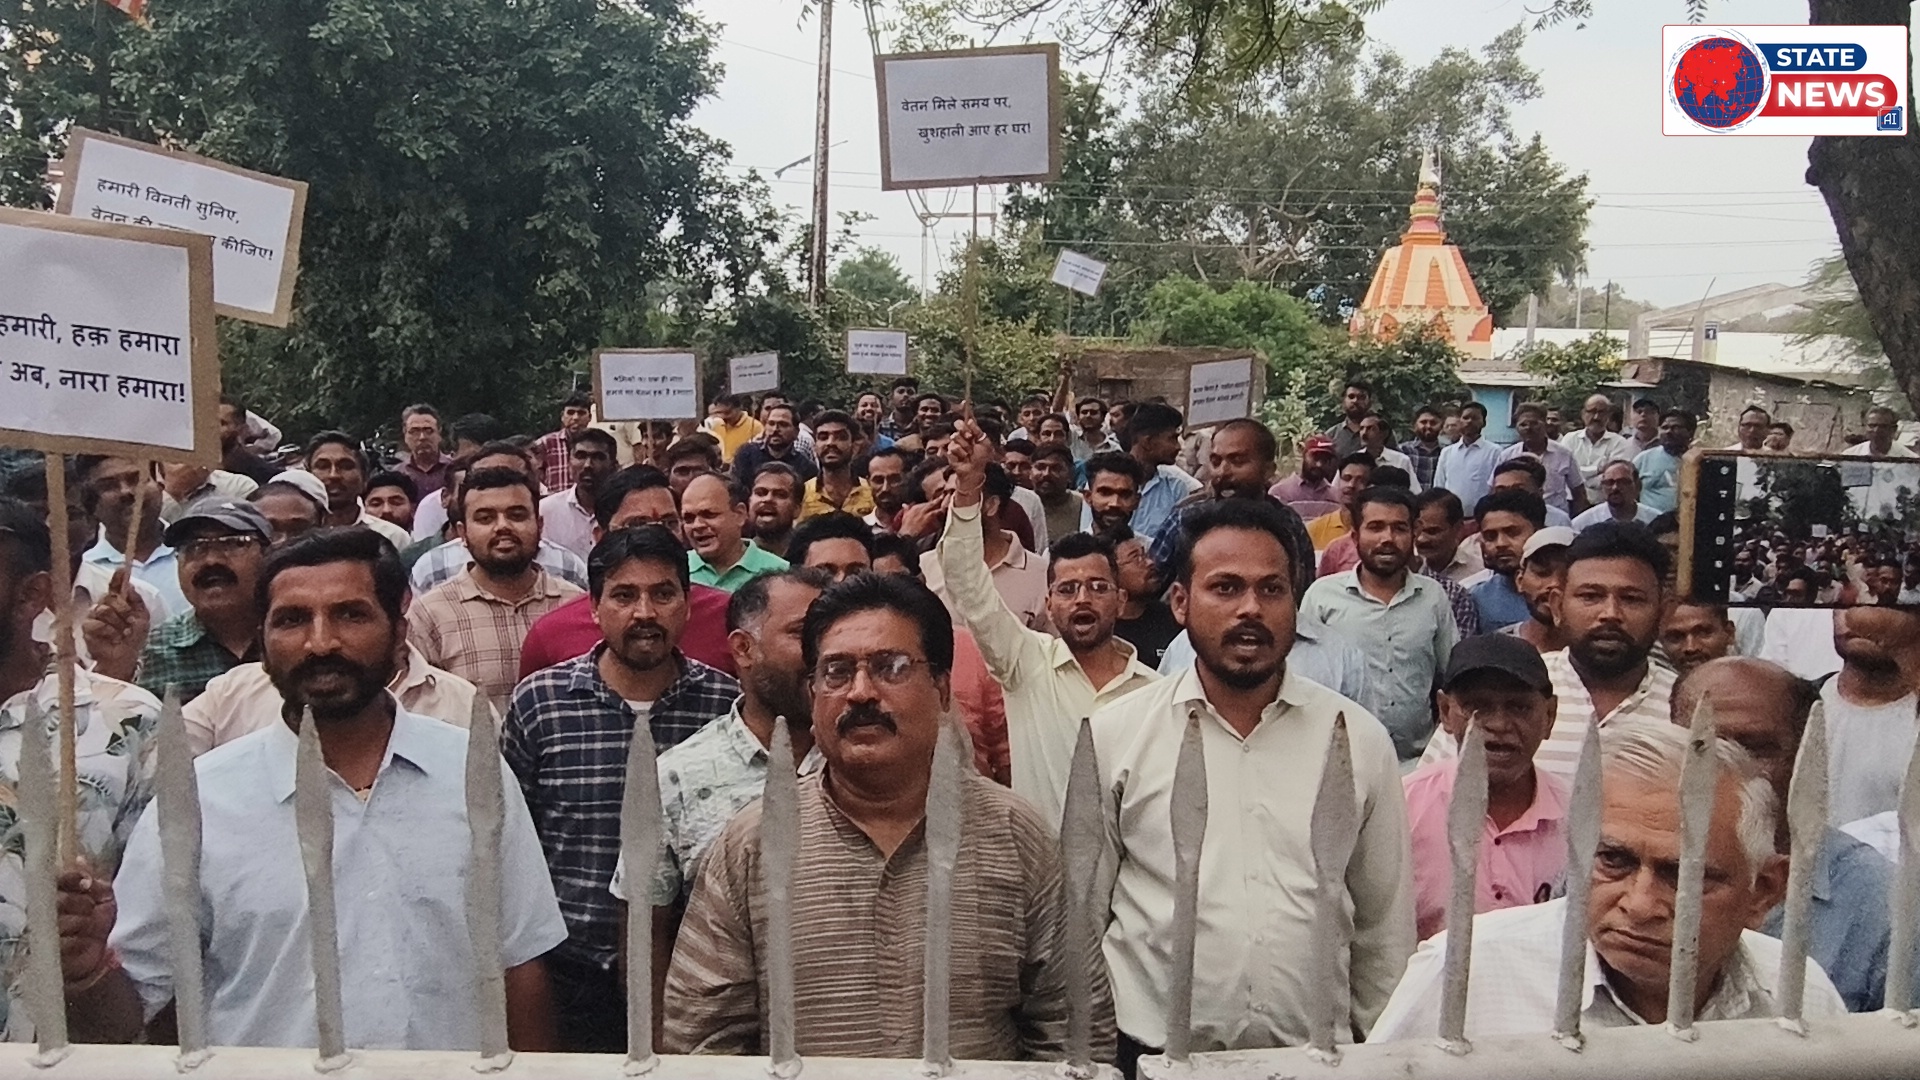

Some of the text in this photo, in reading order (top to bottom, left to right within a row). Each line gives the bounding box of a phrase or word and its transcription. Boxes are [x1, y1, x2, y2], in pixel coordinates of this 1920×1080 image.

[901, 98, 928, 112] वेतन
[932, 96, 957, 111] मिले
[961, 97, 990, 110] समय
[917, 122, 1031, 144] खुशहाली आए हर घर!
[97, 178, 240, 224] हमारी विनती सुनिए,
[221, 236, 273, 261] कीजिए!
[71, 324, 111, 347] हक़
[118, 329, 180, 355] हमारा
[10, 362, 50, 389] अब,
[59, 369, 110, 392] नारा
[117, 375, 185, 403] हमारा!
